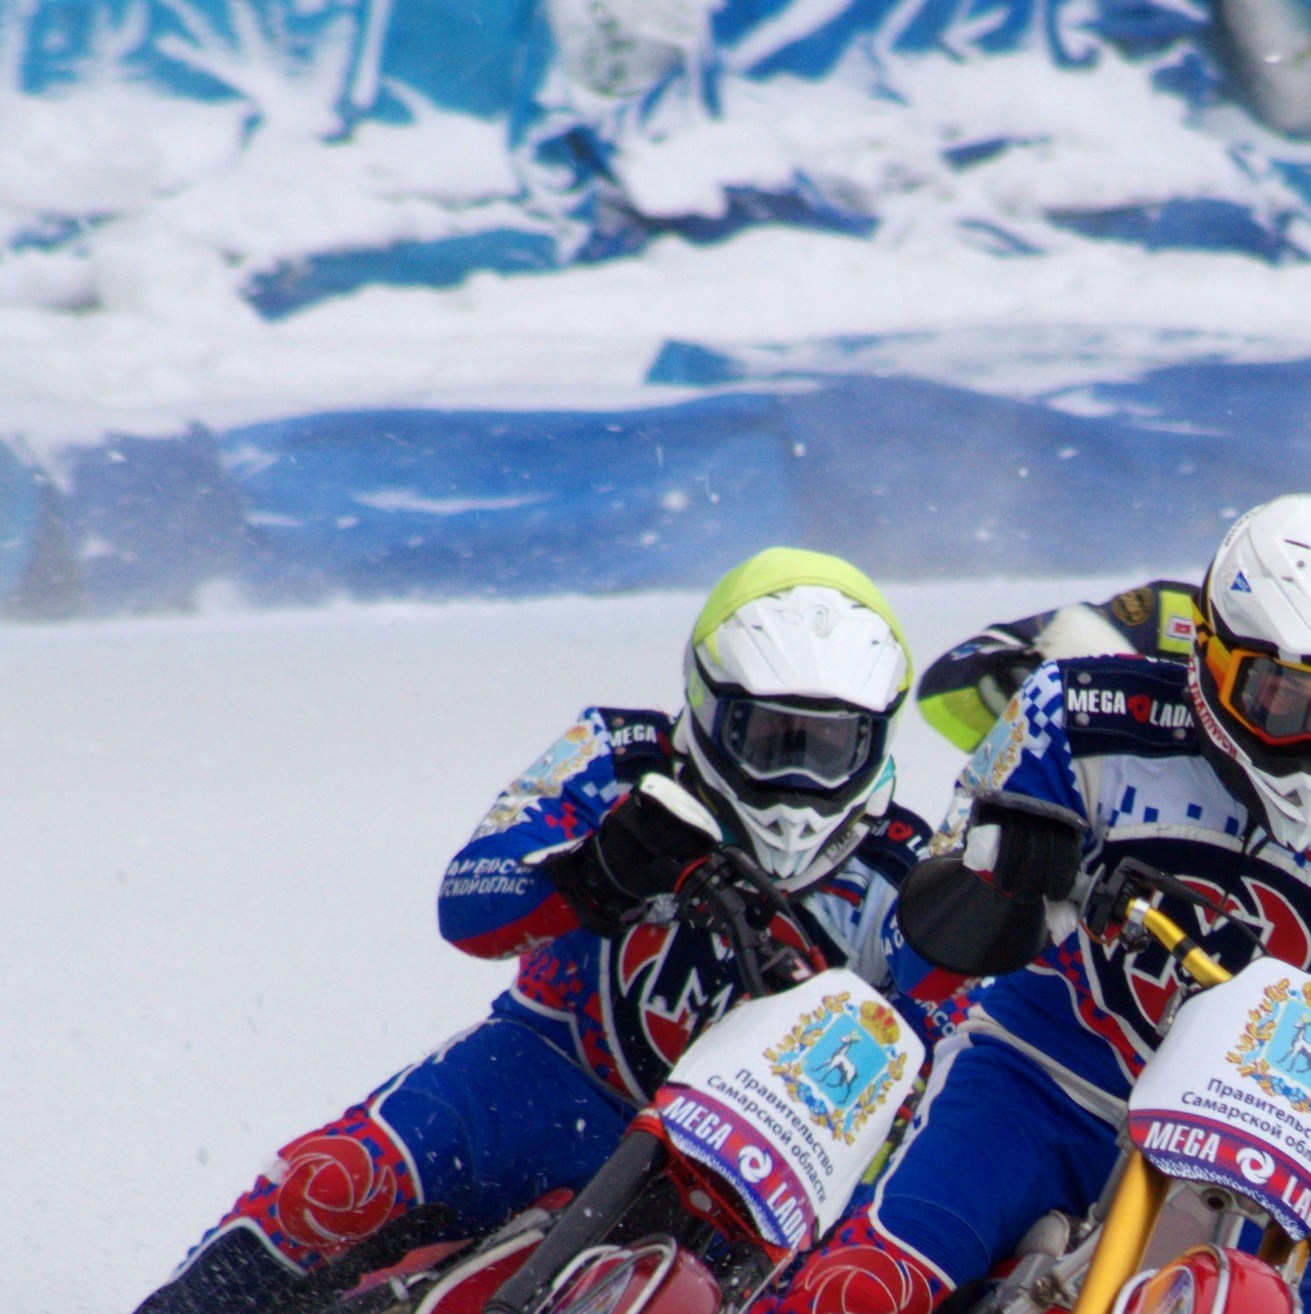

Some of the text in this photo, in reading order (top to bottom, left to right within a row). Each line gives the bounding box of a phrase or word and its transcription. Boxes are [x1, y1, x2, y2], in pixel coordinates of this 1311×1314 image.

[1067, 688, 1126, 715] MEGA
[707, 1075, 827, 1204] Самарской области
[738, 1068, 834, 1177] Правительство
[1143, 1122, 1221, 1163] MEGA
[1181, 1091, 1282, 1138] Самарской
[663, 1097, 809, 1250] MEGA LADA
